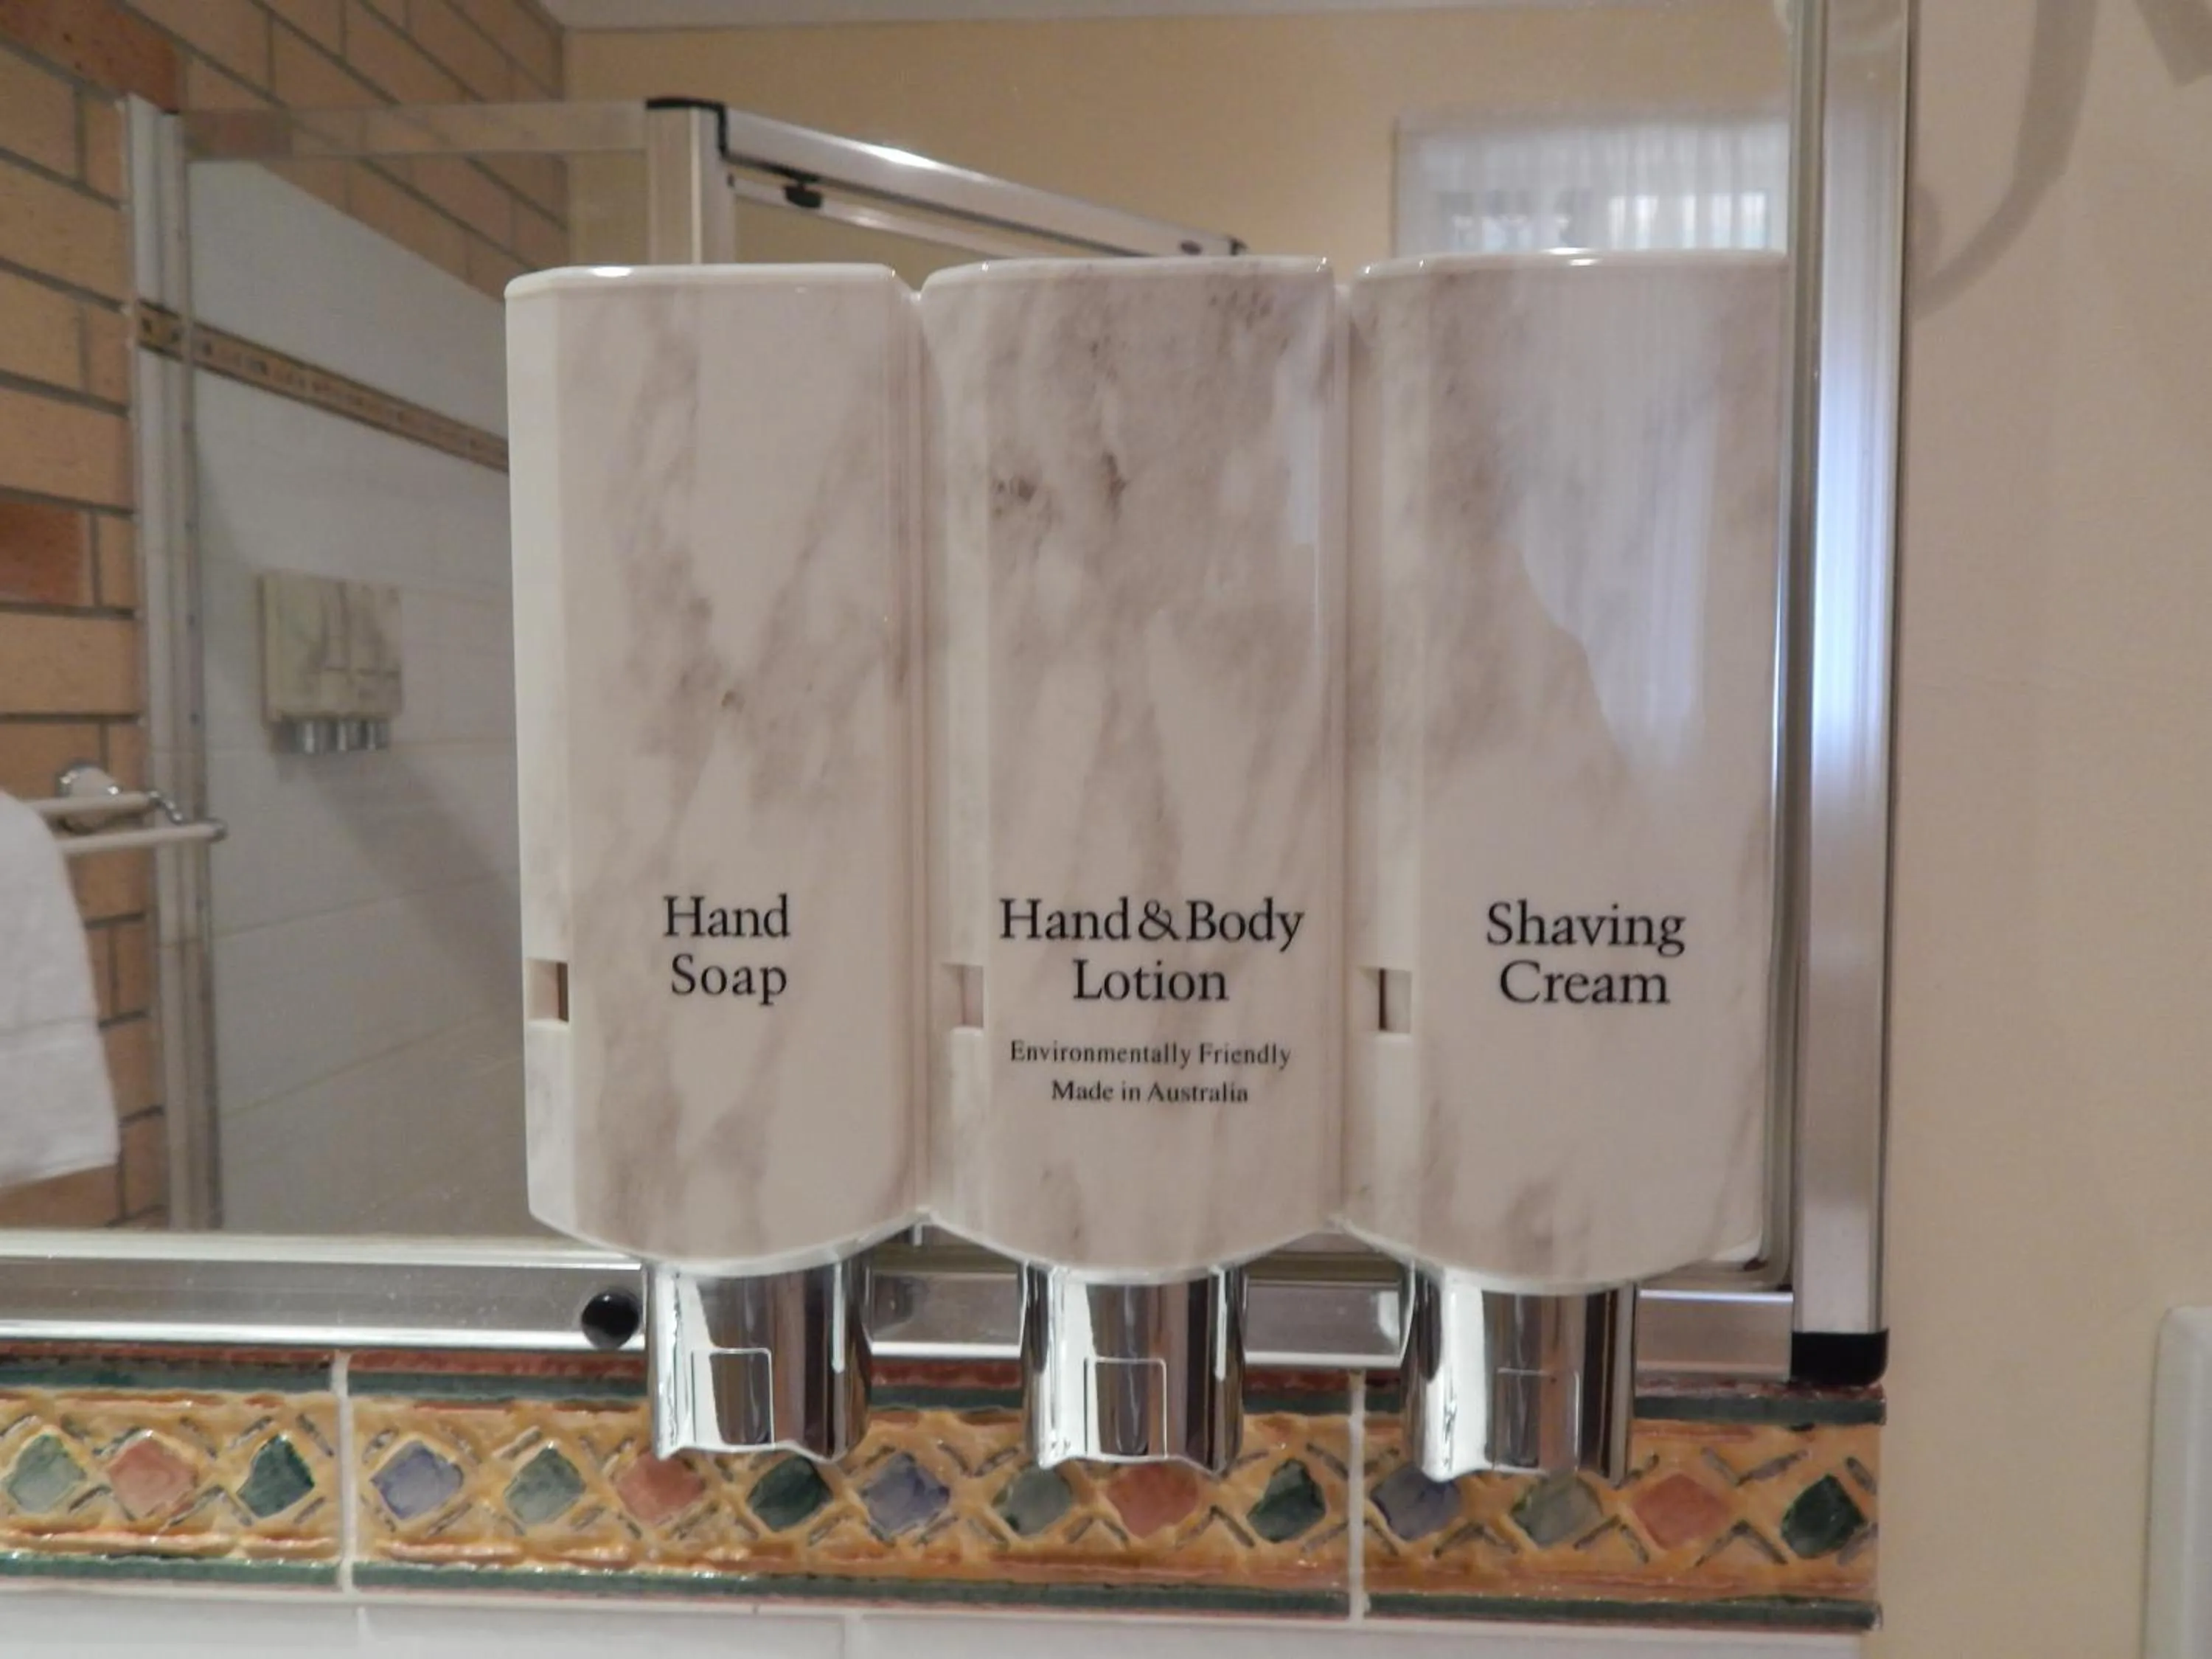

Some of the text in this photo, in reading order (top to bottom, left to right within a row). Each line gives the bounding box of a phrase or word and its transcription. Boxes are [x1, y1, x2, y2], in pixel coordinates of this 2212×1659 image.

[664, 892, 790, 939] Hand
[1486, 898, 1686, 958] Shaving
[671, 953, 787, 1007] Soap
[1073, 958, 1229, 1002] Lotion
[1500, 959, 1671, 1005] Cream
[1010, 1040, 1290, 1071] Environmentally Friendly
[1051, 1079, 1248, 1103] Made in Australia
